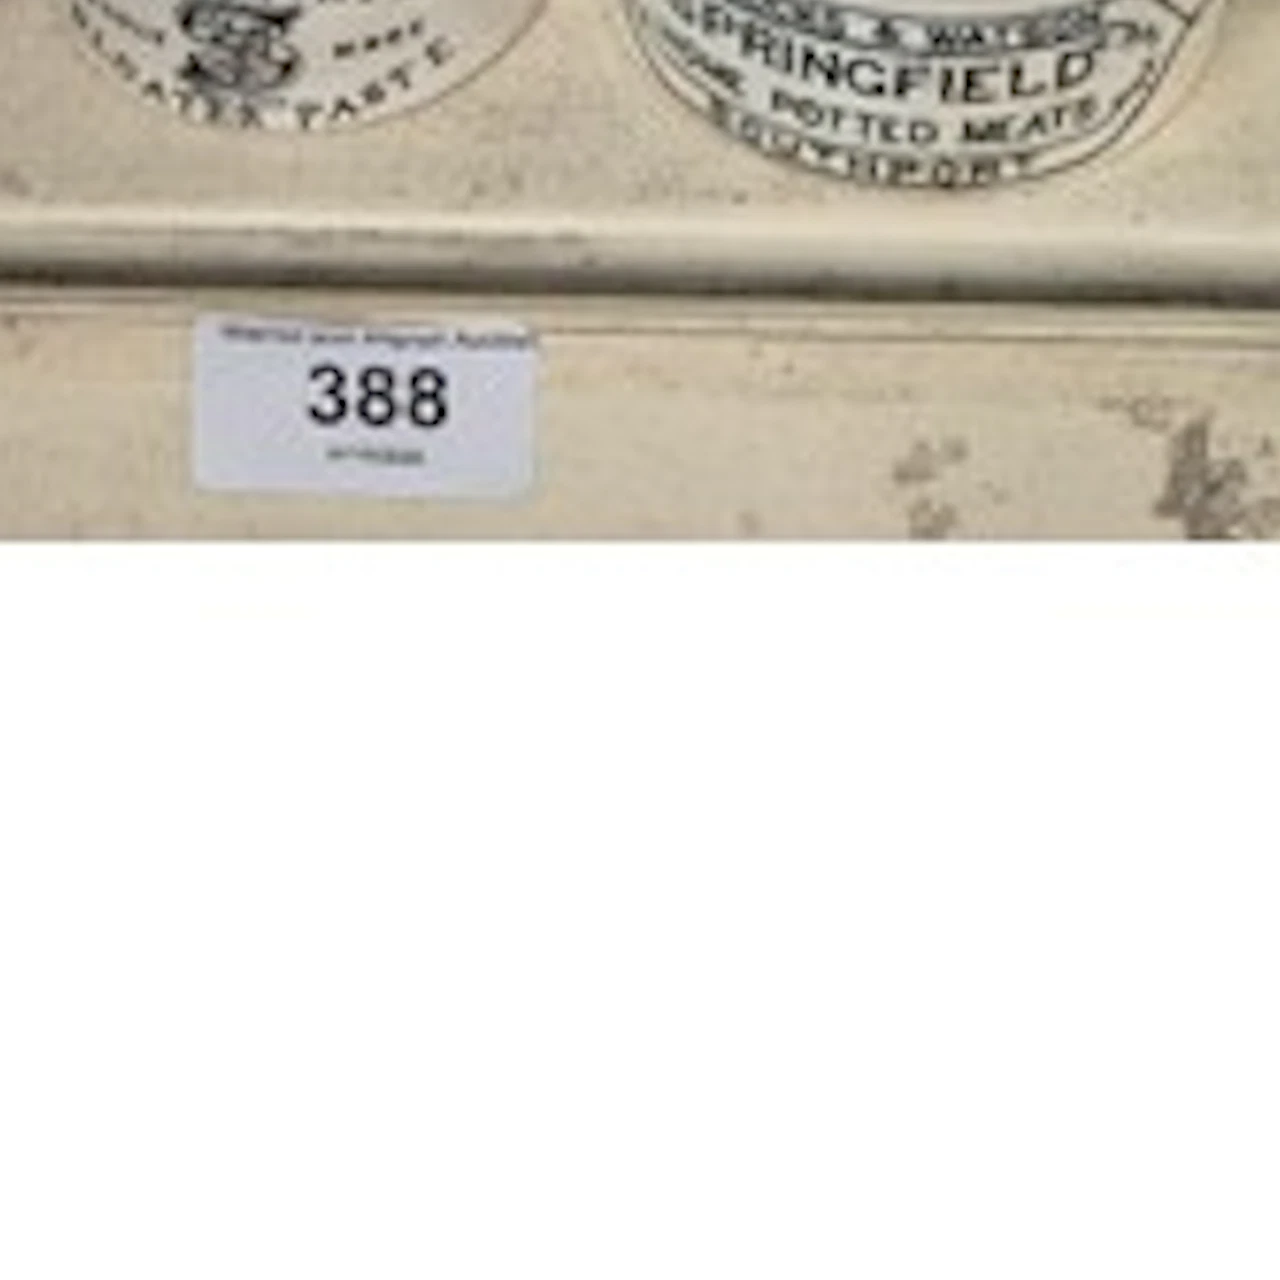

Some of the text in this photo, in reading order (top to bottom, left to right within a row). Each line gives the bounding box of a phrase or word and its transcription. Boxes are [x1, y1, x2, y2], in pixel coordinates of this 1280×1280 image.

[770, 88, 940, 148] POTTED
[960, 95, 1100, 146] MEATS
[308, 363, 448, 427] 388
